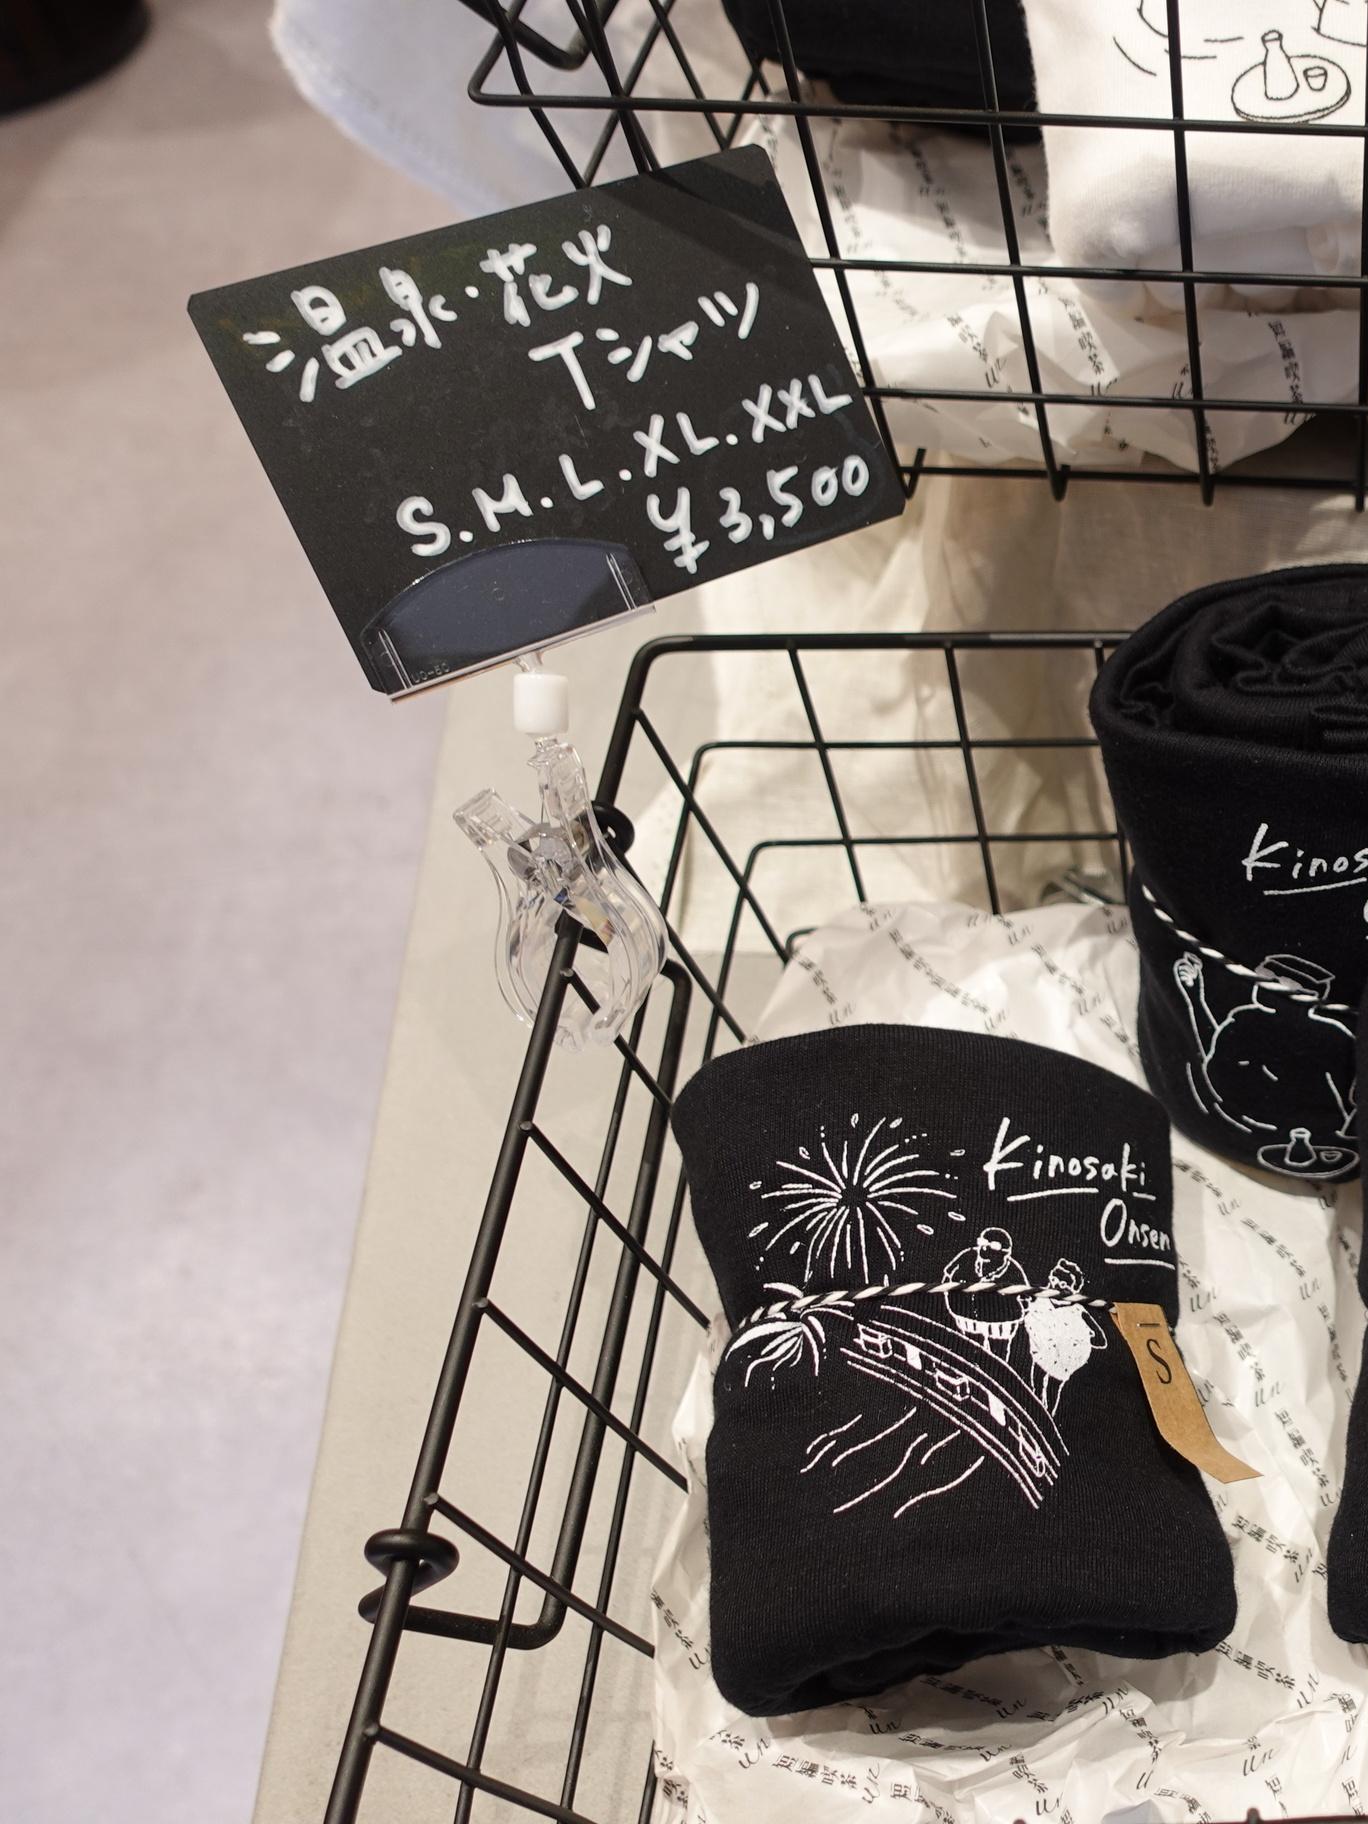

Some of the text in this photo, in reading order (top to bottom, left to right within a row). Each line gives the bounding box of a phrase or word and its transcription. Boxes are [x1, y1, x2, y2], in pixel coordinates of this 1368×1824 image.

[528, 282, 760, 411] Tシャツ
[982, 1116, 1146, 1192] Kinosaki
[1100, 1198, 1172, 1251] Onsen
[1146, 1338, 1173, 1385] S
